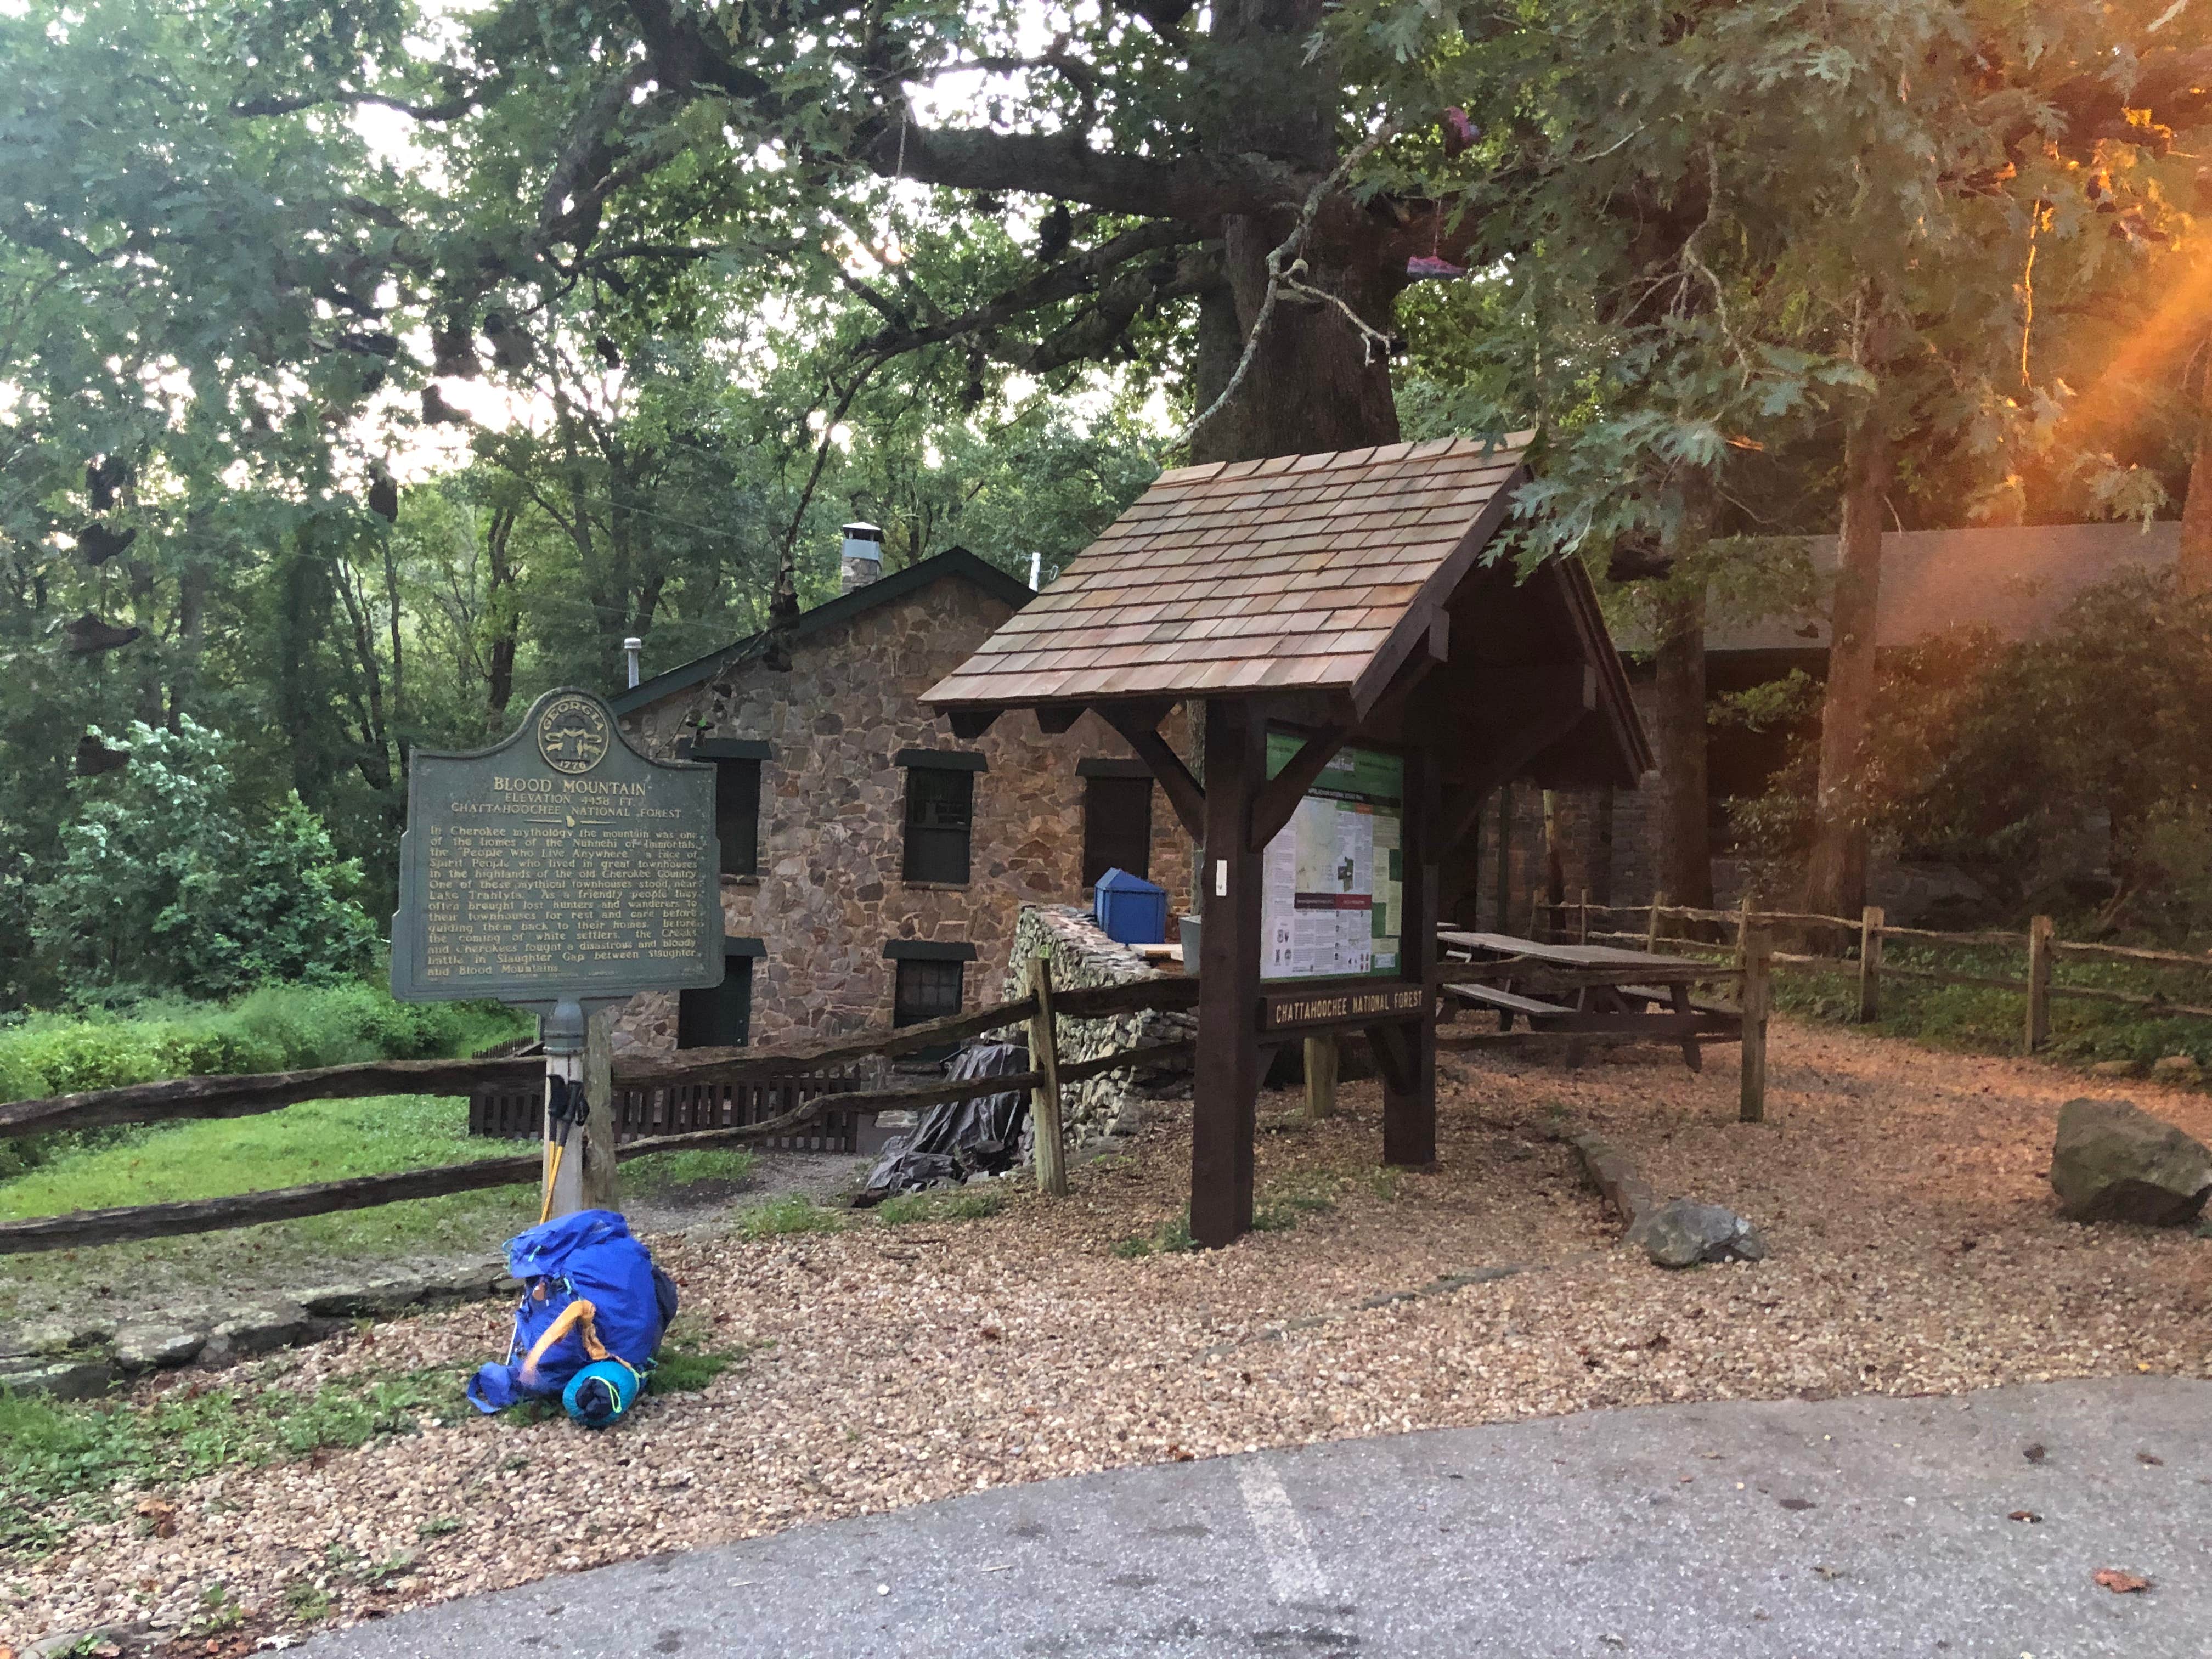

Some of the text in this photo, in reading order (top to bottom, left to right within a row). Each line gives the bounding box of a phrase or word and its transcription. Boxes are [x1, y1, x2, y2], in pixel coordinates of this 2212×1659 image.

[543, 702, 603, 731] GEORGIA
[494, 777, 646, 796] BLOOD MOUNTAIN
[505, 793, 570, 803] ELEVATION
[581, 797, 610, 805] 4458
[452, 802, 681, 818] CHATTAHOOCHEE NATIONAL FOREST
[450, 826, 506, 836] Cherokee
[513, 828, 573, 838] mythology
[603, 829, 650, 838] mountain
[431, 837, 442, 845] of
[453, 837, 472, 845] the
[481, 837, 516, 846] homes
[524, 838, 537, 846] of
[431, 848, 449, 856] the
[510, 848, 534, 857] Who
[541, 849, 565, 857] Live
[430, 858, 462, 868] Spirit
[472, 859, 509, 868] People
[549, 859, 575, 868] lived
[601, 861, 629, 870] great
[639, 860, 697, 868] townhouses
[430, 870, 441, 878] in
[475, 870, 530, 879] highlands
[556, 870, 572, 878] the
[579, 870, 596, 878] old
[602, 870, 650, 878] Cherokee
[430, 880, 452, 889] One
[460, 880, 472, 889] of
[480, 880, 510, 889] these
[517, 881, 565, 890] mythical
[572, 880, 632, 888] townhouses
[430, 891, 459, 900] Lake
[541, 890, 555, 899] As
[579, 890, 622, 899] friendly
[632, 889, 667, 898] people
[675, 889, 697, 898] they
[428, 902, 459, 911] often
[469, 901, 514, 911] brought
[523, 901, 544, 910] lost
[553, 901, 594, 909] hunters
[429, 912, 458, 921] their
[469, 911, 536, 921] townhouses
[663, 909, 697, 917] before
[428, 924, 474, 933] guiding
[483, 923, 511, 931] them
[521, 922, 548, 930] back
[578, 921, 605, 929] their
[429, 934, 447, 943] the
[459, 933, 500, 944] coming
[512, 933, 524, 941] of
[537, 932, 566, 940] white
[636, 930, 651, 938] the
[428, 945, 449, 954] and
[456, 944, 517, 953] Cherokees
[525, 943, 561, 953] fought
[580, 941, 633, 950] disastrous
[663, 939, 696, 948] bloody
[428, 956, 463, 964] battle
[475, 955, 486, 964] in
[496, 954, 552, 964] Slaughter
[562, 952, 584, 962] Gap
[428, 968, 449, 976] and
[459, 966, 492, 975] Blood
[1276, 990, 1422, 1023] CHATTAHOOCHEE NATIONAL FOREST
